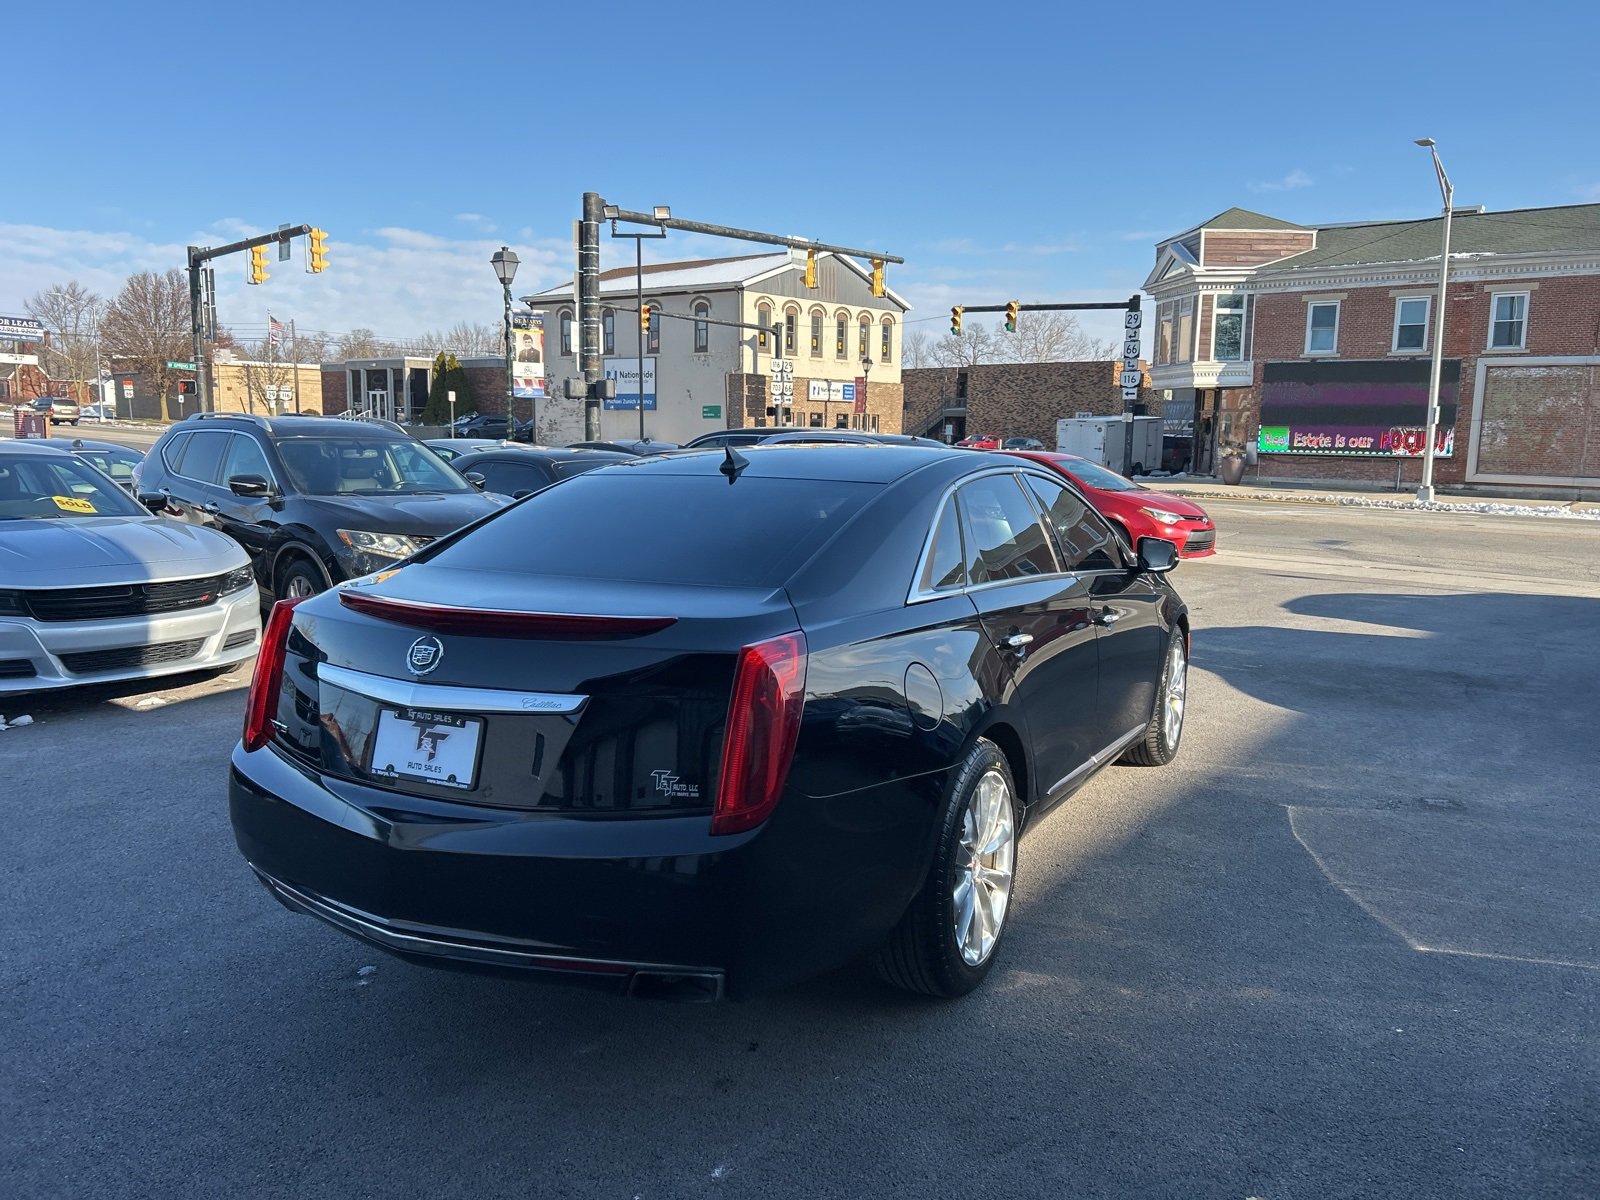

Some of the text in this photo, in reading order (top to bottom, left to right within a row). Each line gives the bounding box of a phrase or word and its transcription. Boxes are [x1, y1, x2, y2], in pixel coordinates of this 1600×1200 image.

[11, 319, 39, 328] LEASE
[1127, 314, 1139, 324] 29
[1126, 344, 1137, 354] 66
[772, 361, 780, 369] 116
[784, 361, 793, 370] 29
[1123, 375, 1137, 384] 116
[784, 384, 793, 392] 66
[1293, 431, 1332, 449] Estate
[1335, 433, 1346, 448] is
[1348, 436, 1374, 448] our
[56, 499, 92, 509] SOLD
[521, 697, 562, 709] Cadillac
[416, 712, 432, 721] AUTO
[433, 713, 452, 723] SALES
[407, 761, 442, 774] AUTO SALES
